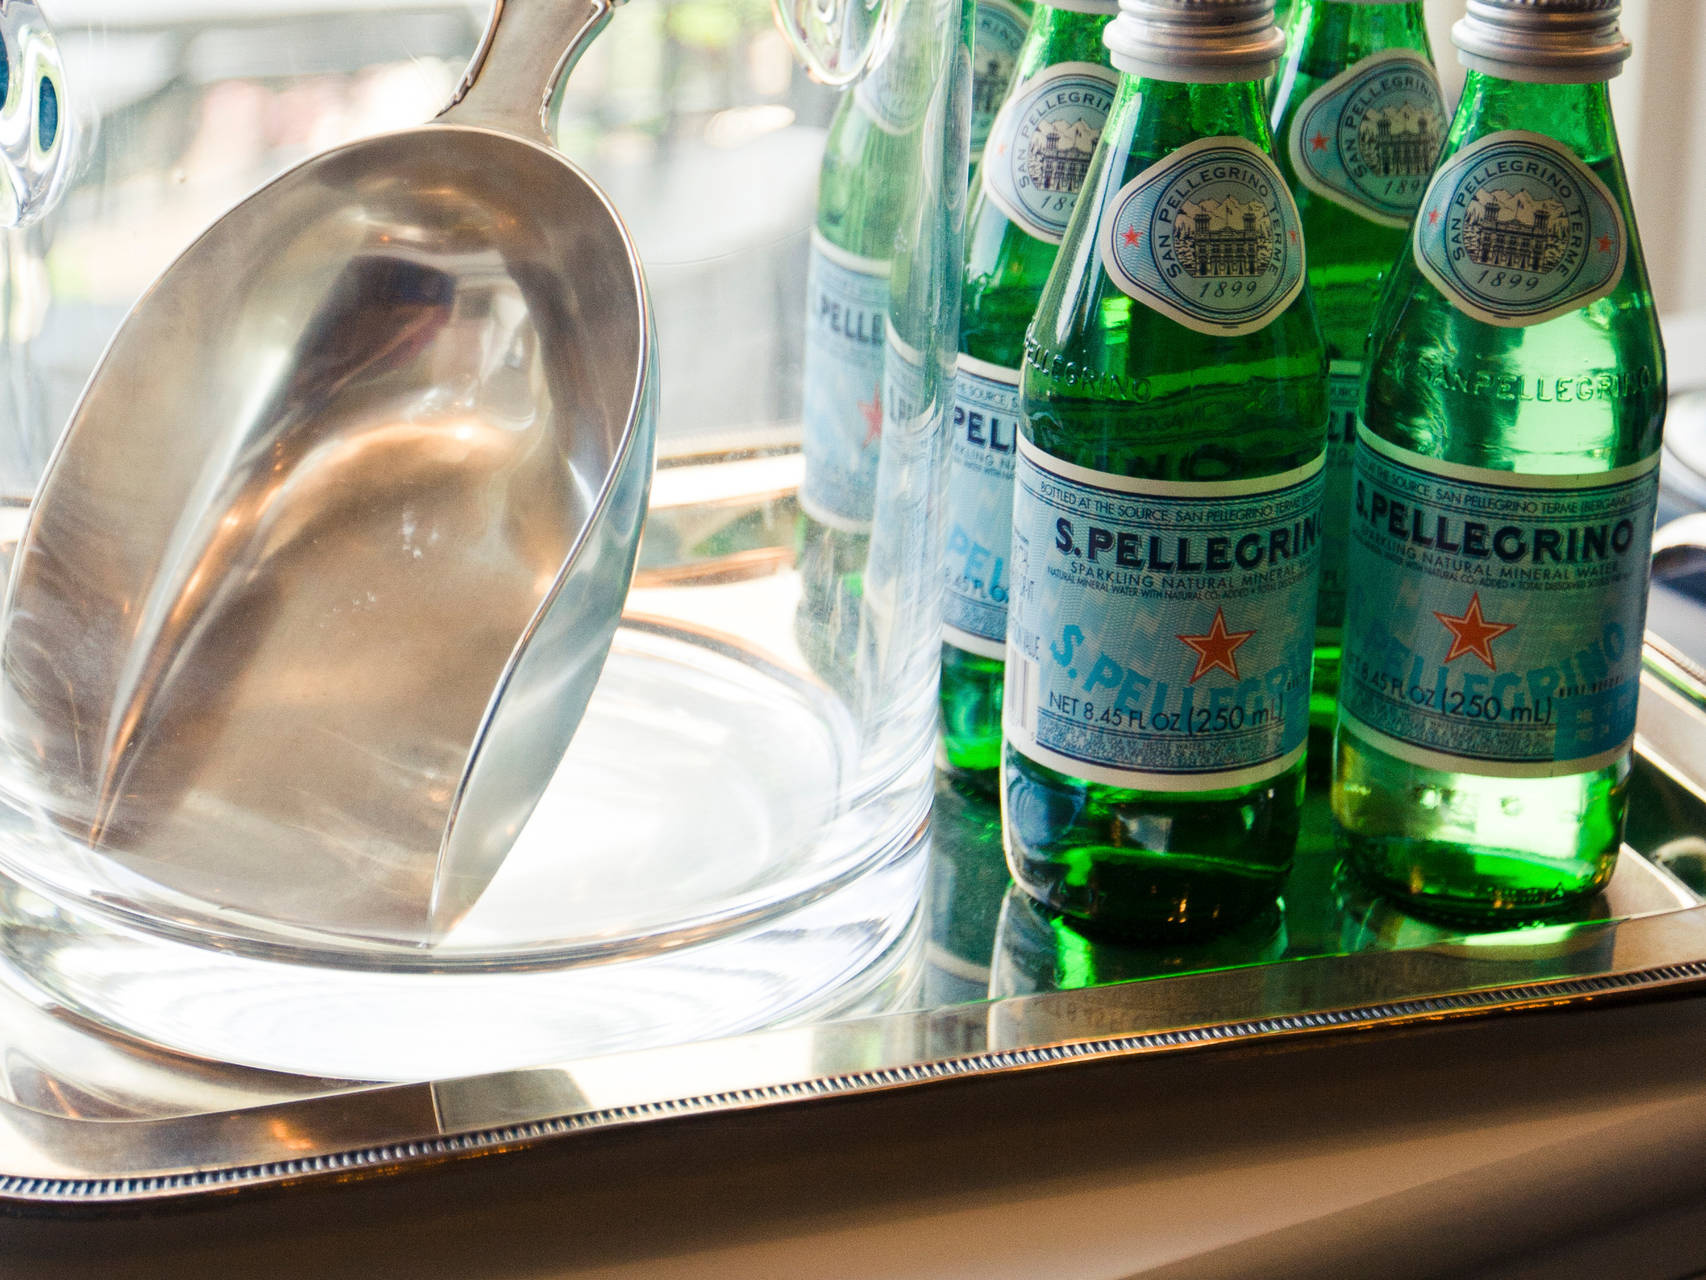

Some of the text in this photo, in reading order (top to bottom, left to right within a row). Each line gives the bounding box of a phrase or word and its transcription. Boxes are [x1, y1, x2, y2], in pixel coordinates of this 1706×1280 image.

[1017, 91, 1112, 189] SAN PELLEGRIN
[1345, 138, 1369, 178] SAN
[1040, 194, 1076, 212] 18
[1384, 179, 1421, 197] 189
[1159, 166, 1283, 279] SAN PELLEGRINO TERME
[1451, 160, 1584, 278] SAN PELLEGRINO TERME
[1199, 280, 1258, 299] 1899
[1476, 269, 1540, 293] 1899
[1040, 481, 1077, 506] BOTTLED
[1078, 497, 1091, 510] AT
[1094, 501, 1115, 516] THE
[1175, 509, 1202, 523] SAN
[1436, 488, 1461, 504] SAN
[1464, 494, 1538, 514] PELLEGRINO
[1356, 479, 1635, 565] S.PELLEGRINO
[1071, 561, 1154, 589] SPARKLING
[1162, 576, 1233, 591] NATURAL
[1242, 567, 1297, 586] MINERAL
[1421, 551, 1492, 577] NATURAL
[1500, 567, 1570, 581] MINERAL
[1577, 561, 1620, 578] WATER
[1112, 584, 1139, 598] WATER
[1140, 587, 1163, 600] WITH
[1048, 690, 1285, 737] NET 8.45 FL OZ (250 mL)
[1409, 686, 1436, 708] OZ
[1441, 687, 1501, 721] (250
[1511, 695, 1552, 726] mL)
